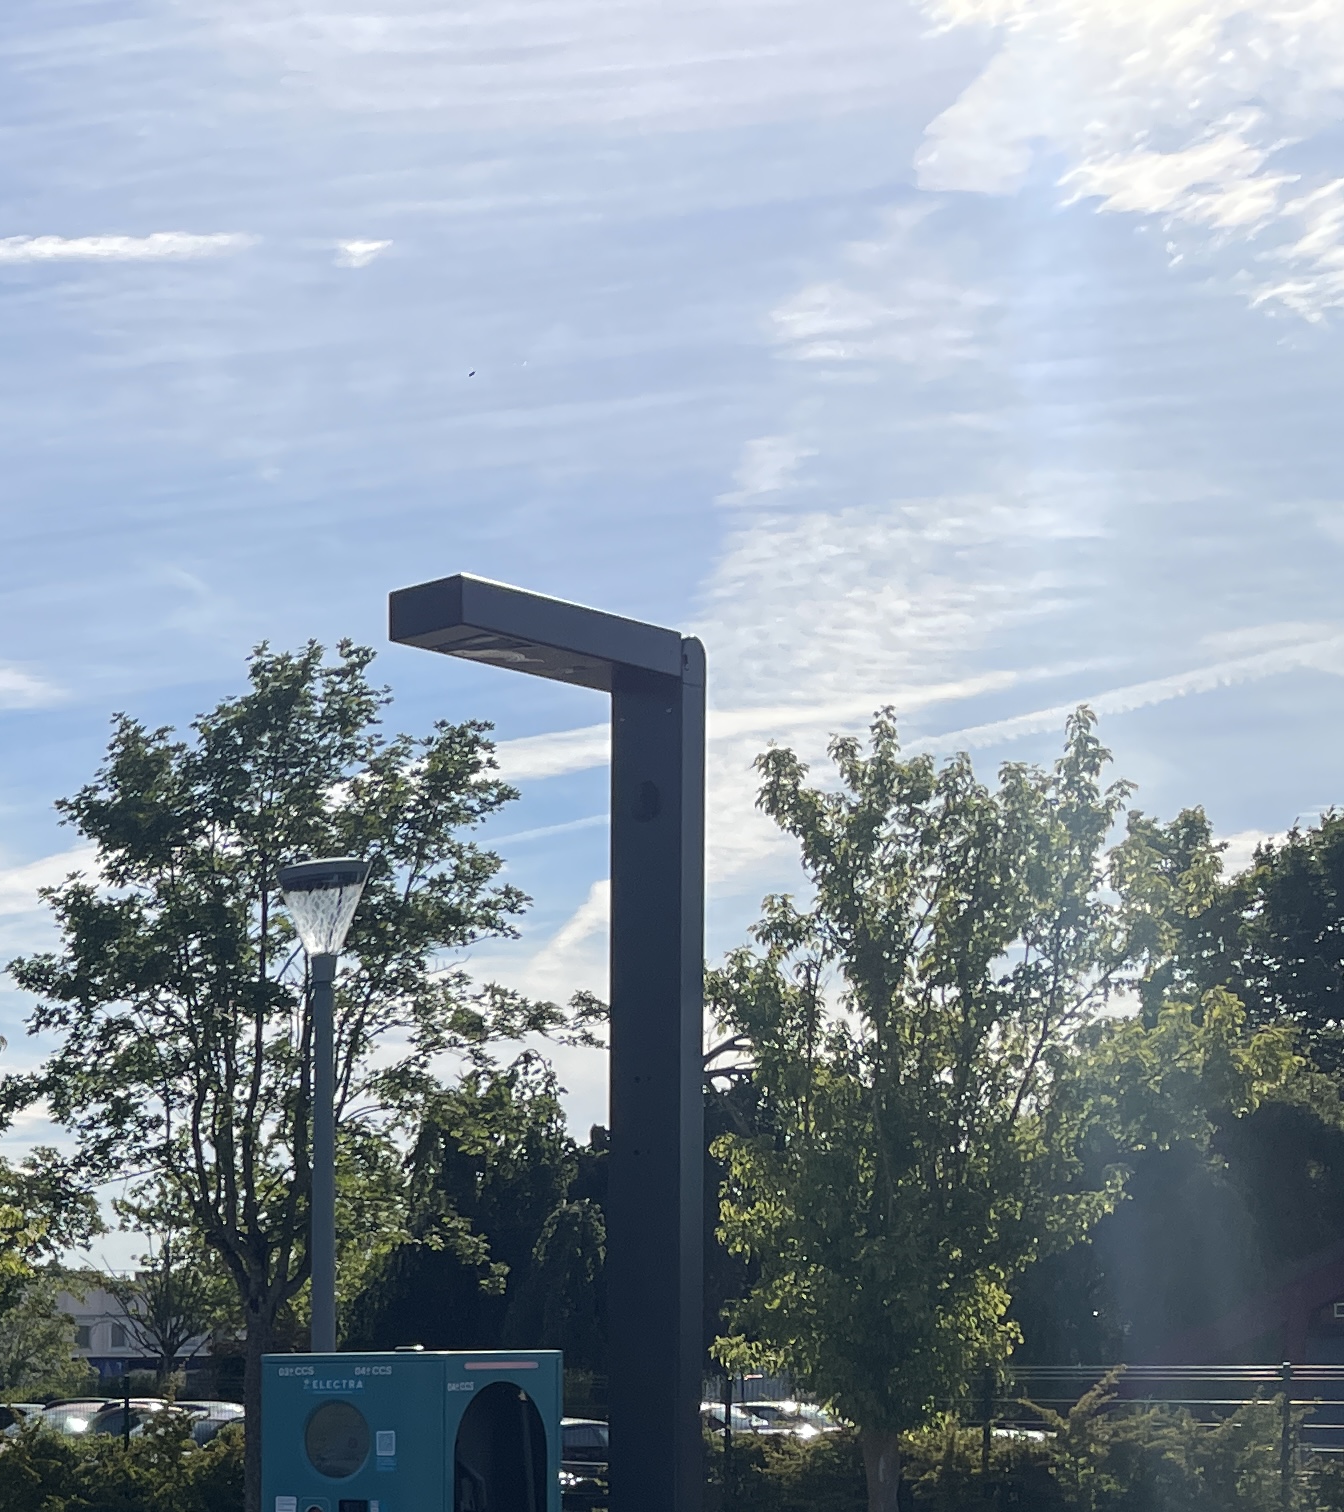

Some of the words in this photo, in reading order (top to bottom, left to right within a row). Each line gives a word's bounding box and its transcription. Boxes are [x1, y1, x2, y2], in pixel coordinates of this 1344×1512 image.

[294, 1365, 315, 1376] CCS
[372, 1365, 392, 1375] CCS
[312, 1379, 363, 1389] ELECTRA
